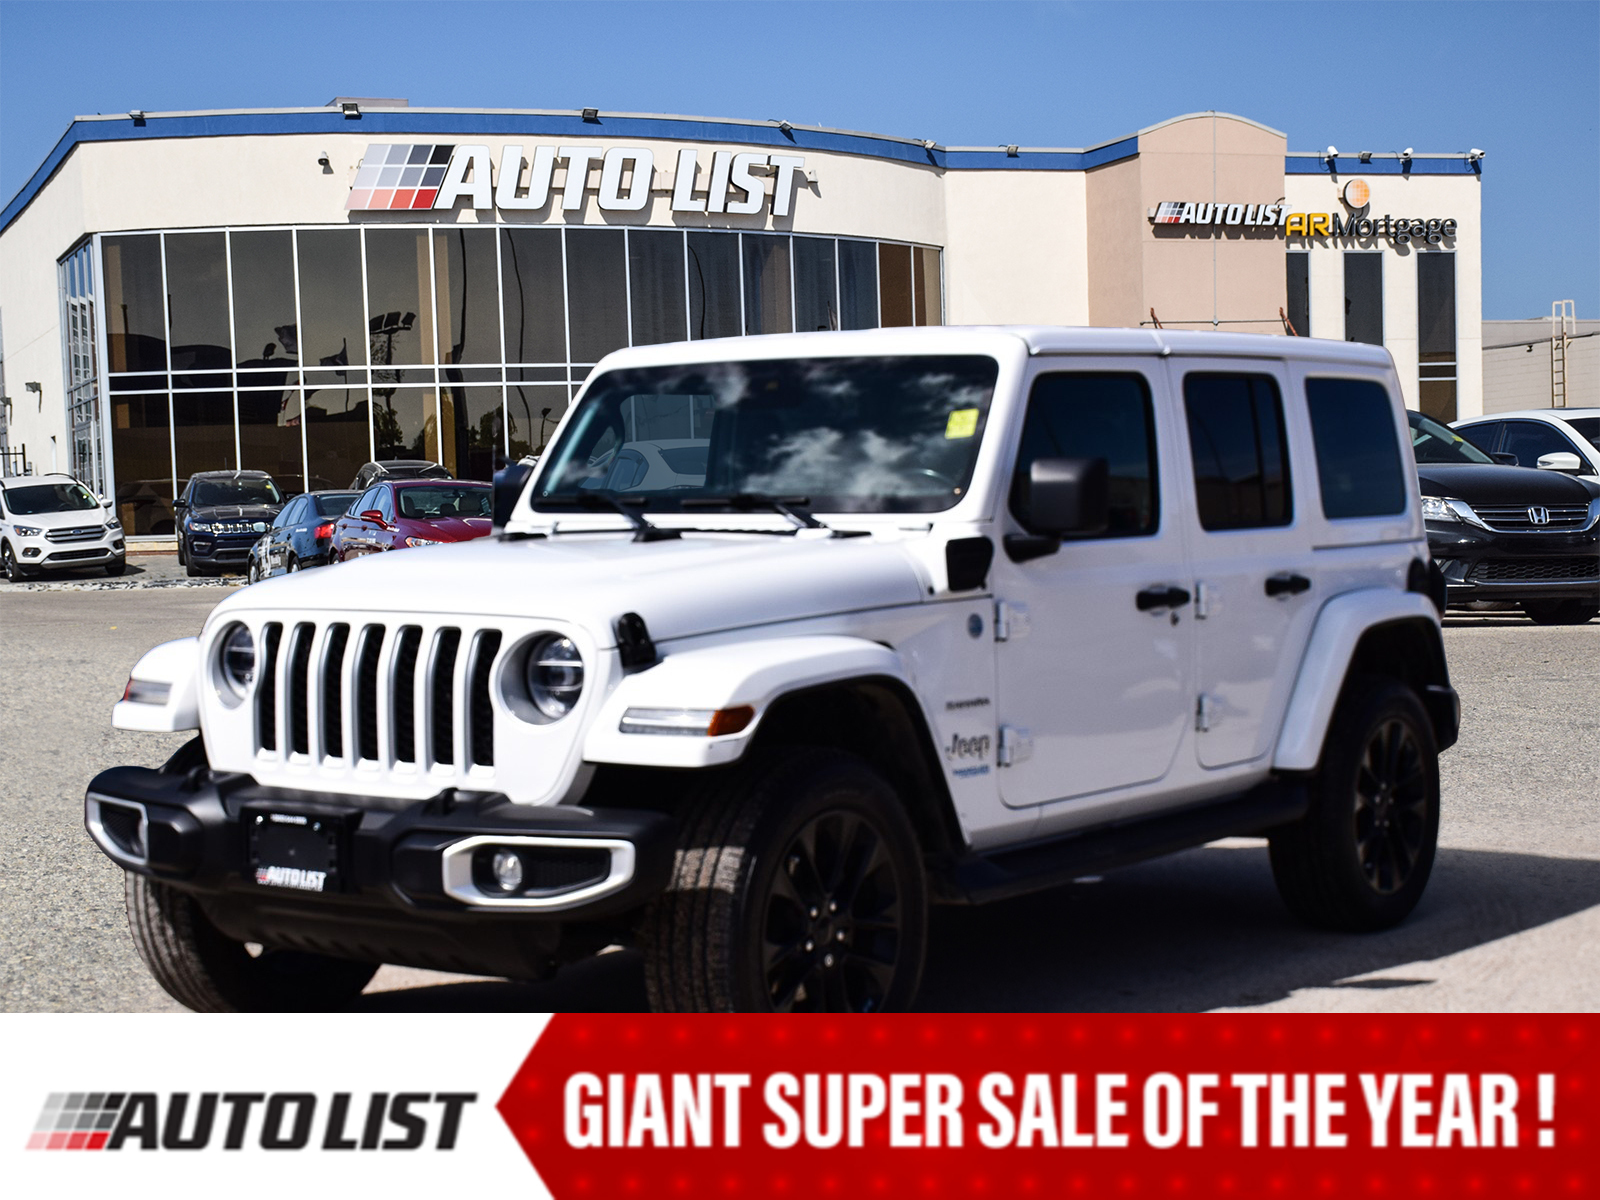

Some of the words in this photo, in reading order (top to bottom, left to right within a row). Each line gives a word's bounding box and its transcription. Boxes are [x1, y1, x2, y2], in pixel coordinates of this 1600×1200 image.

[434, 144, 655, 211] AUTO
[672, 148, 806, 217] LIST
[1179, 202, 1245, 226] AUTO
[1243, 204, 1293, 227] LIST
[1286, 212, 1331, 237] AR
[1332, 212, 1458, 245] Mortgage
